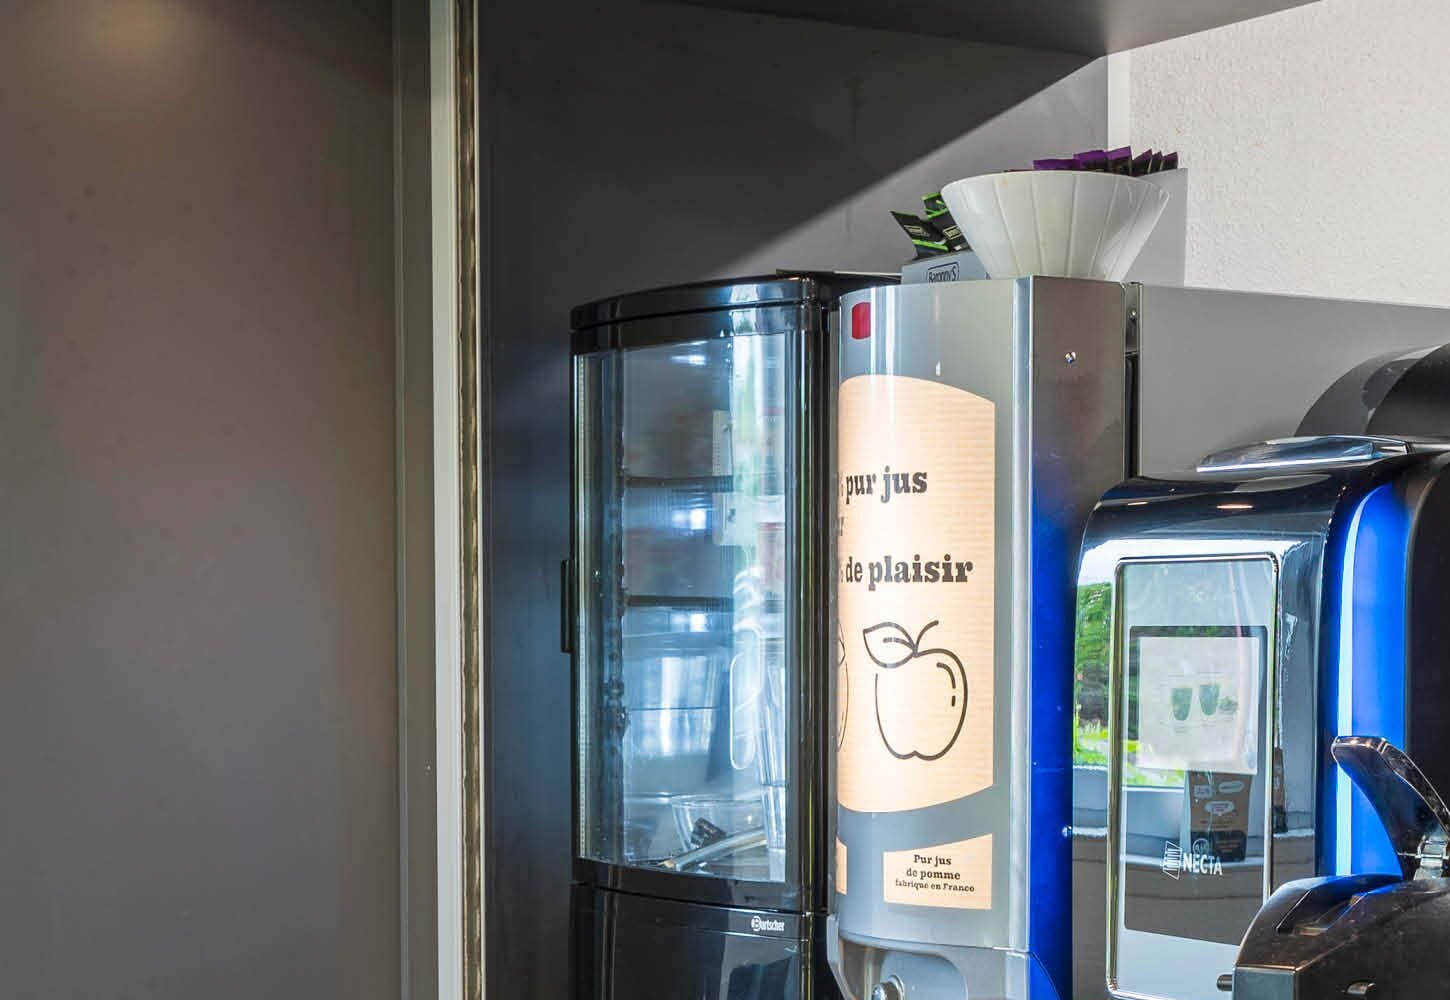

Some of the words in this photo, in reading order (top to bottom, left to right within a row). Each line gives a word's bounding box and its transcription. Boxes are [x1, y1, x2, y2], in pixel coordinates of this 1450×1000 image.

[846, 474, 877, 505] pur
[881, 465, 928, 504] jus
[845, 556, 864, 583] de
[868, 553, 974, 592] plaisir
[913, 854, 933, 865] Pur
[934, 855, 952, 868] jus
[1182, 852, 1223, 876] NECTA
[906, 867, 918, 878] de
[919, 870, 961, 881] pomme
[942, 884, 975, 893] France
